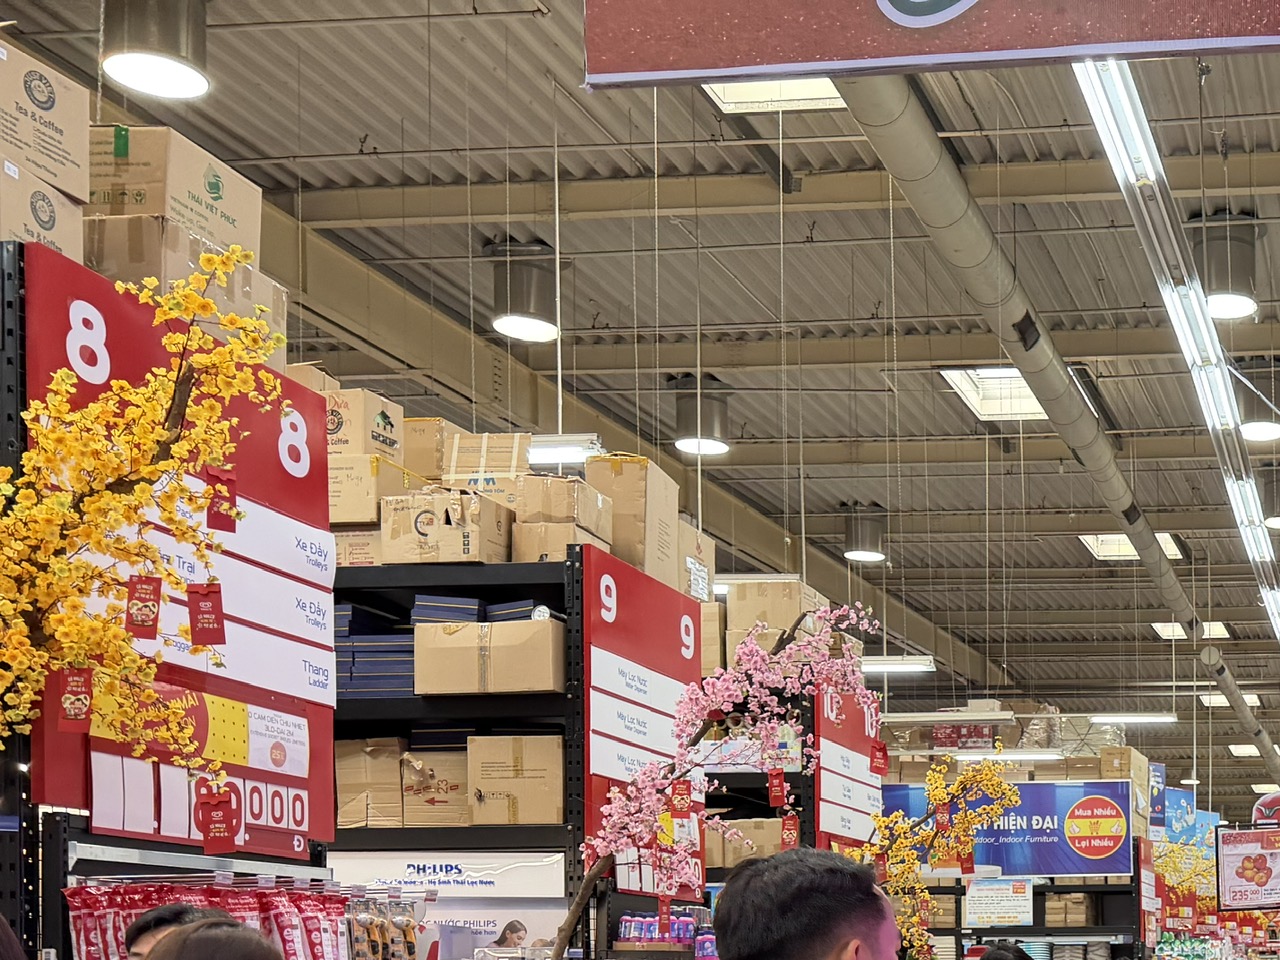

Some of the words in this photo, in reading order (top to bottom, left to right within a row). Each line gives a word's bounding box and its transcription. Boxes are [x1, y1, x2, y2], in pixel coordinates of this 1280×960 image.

[15, 101, 28, 117] Tea
[30, 112, 38, 123] &
[39, 116, 64, 136] Coffee
[23, 223, 34, 238] Tea
[66, 300, 111, 384] 8
[278, 408, 310, 478] 8
[295, 536, 307, 552] Xe
[310, 542, 329, 562] Đẩy
[176, 555, 195, 575] Trại
[305, 555, 328, 572] Trolleys
[600, 573, 617, 623] 9
[295, 597, 307, 612] Xe
[309, 601, 327, 621] Đẩy
[304, 614, 327, 631] Trolleys
[680, 614, 695, 659] 9
[302, 660, 329, 682] Thang
[308, 677, 329, 690] Ladder
[1075, 808, 1092, 817] Mua
[1094, 806, 1117, 816] Nhiều
[995, 813, 1027, 834] HIỆN
[1031, 815, 1058, 834] ĐẠI
[1025, 835, 1059, 844] Furniture
[1092, 837, 1114, 848] Nhiều
[463, 920, 498, 928] PHILIPS
